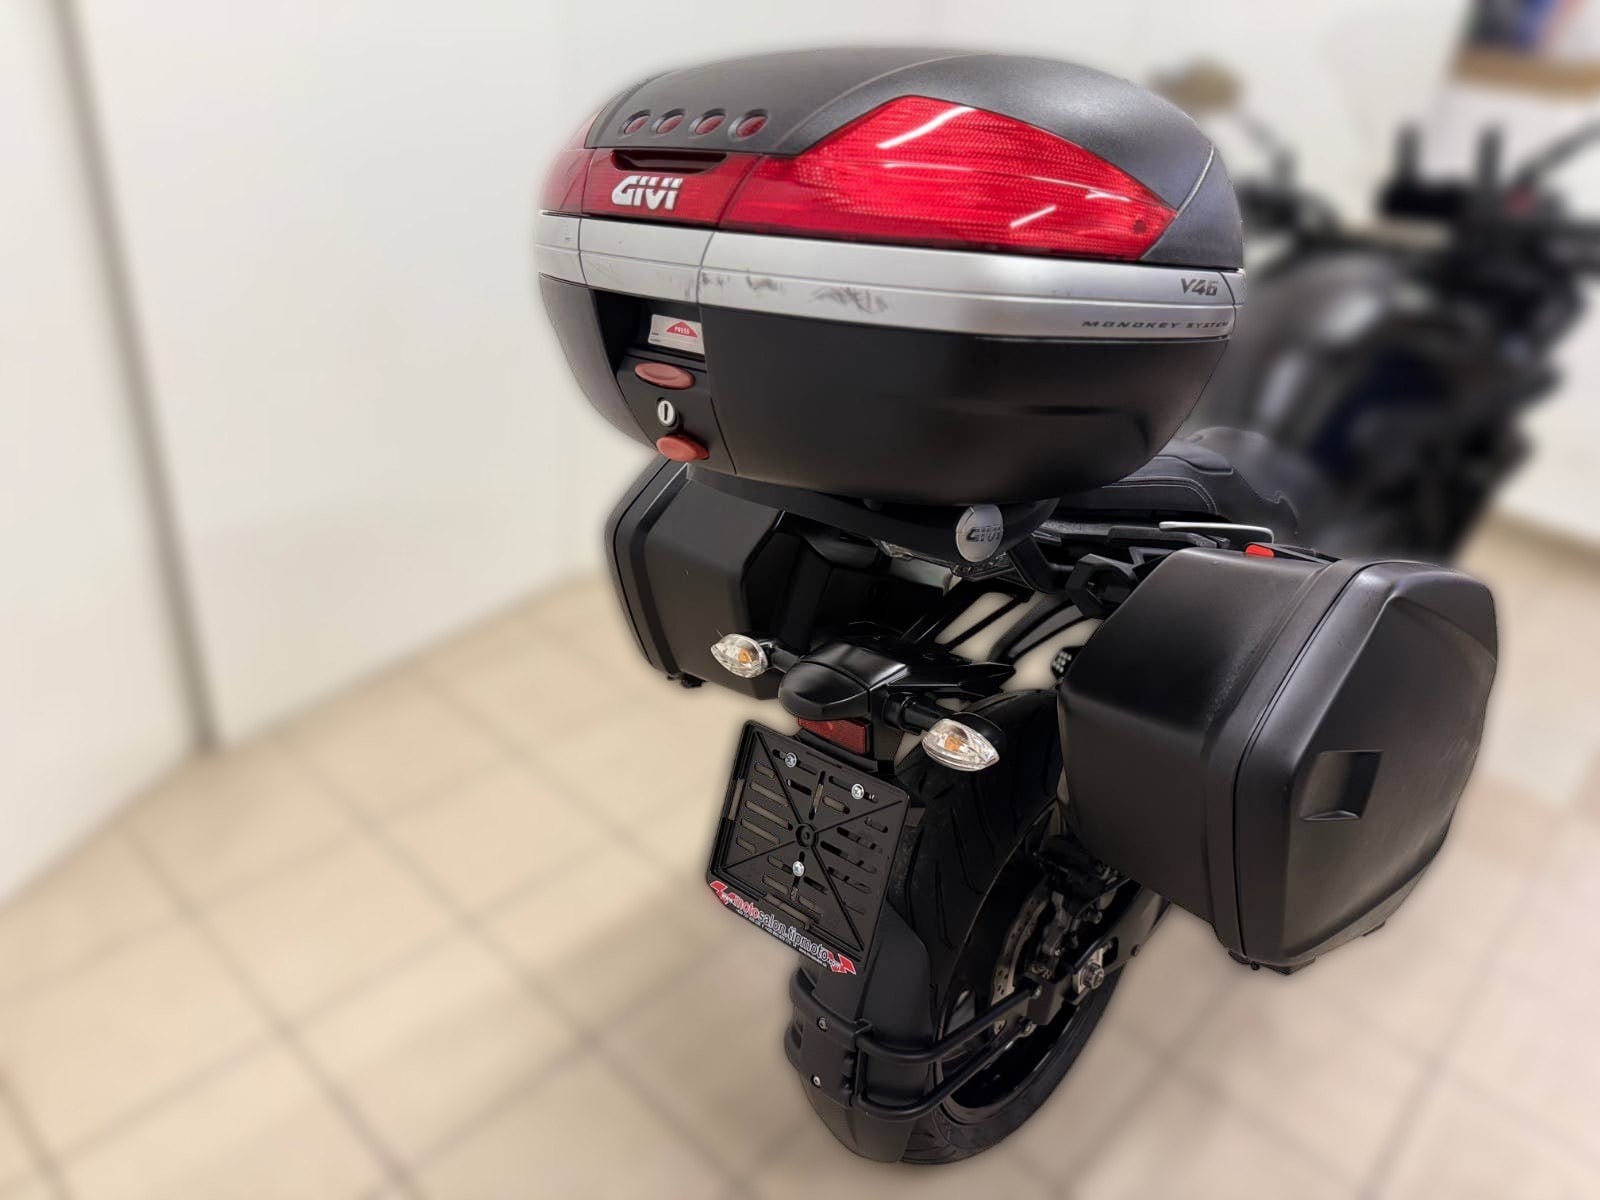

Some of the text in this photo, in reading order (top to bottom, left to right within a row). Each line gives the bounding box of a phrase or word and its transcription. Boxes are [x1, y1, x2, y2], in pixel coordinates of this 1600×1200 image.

[611, 175, 683, 210] GIVI
[1180, 278, 1218, 296] V46
[1081, 320, 1182, 329] MONOKEY
[966, 523, 1001, 542] GIVI
